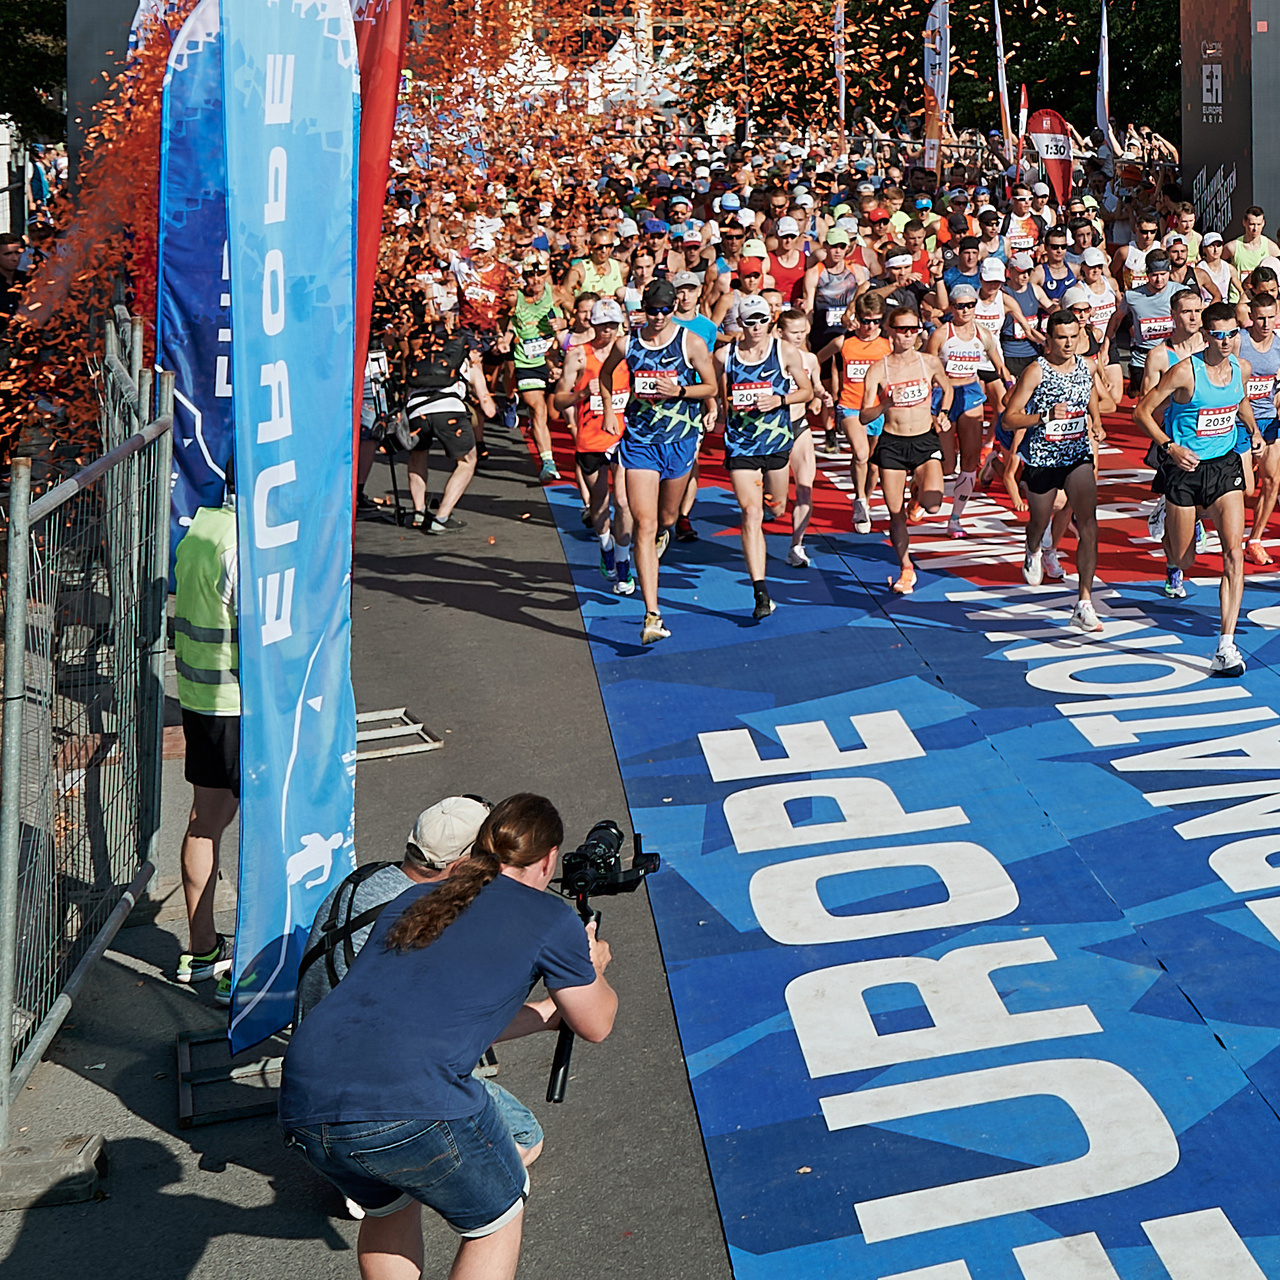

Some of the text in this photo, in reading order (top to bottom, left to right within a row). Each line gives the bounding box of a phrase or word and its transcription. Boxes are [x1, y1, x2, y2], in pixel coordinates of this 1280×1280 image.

[1202, 106, 1223, 115] EUROPE
[1202, 114, 1223, 123] ASIA
[1045, 144, 1065, 155] 1:30
[1156, 324, 1178, 333] 2475
[254, 54, 299, 646] EUROPE
[531, 343, 547, 353] 232
[852, 367, 866, 376] 20
[951, 363, 975, 372] 2044
[1249, 382, 1269, 393] 1925
[901, 388, 923, 400] 033
[595, 397, 625, 408] 249
[1052, 421, 1080, 433] 2037
[1204, 415, 1233, 428] 2039
